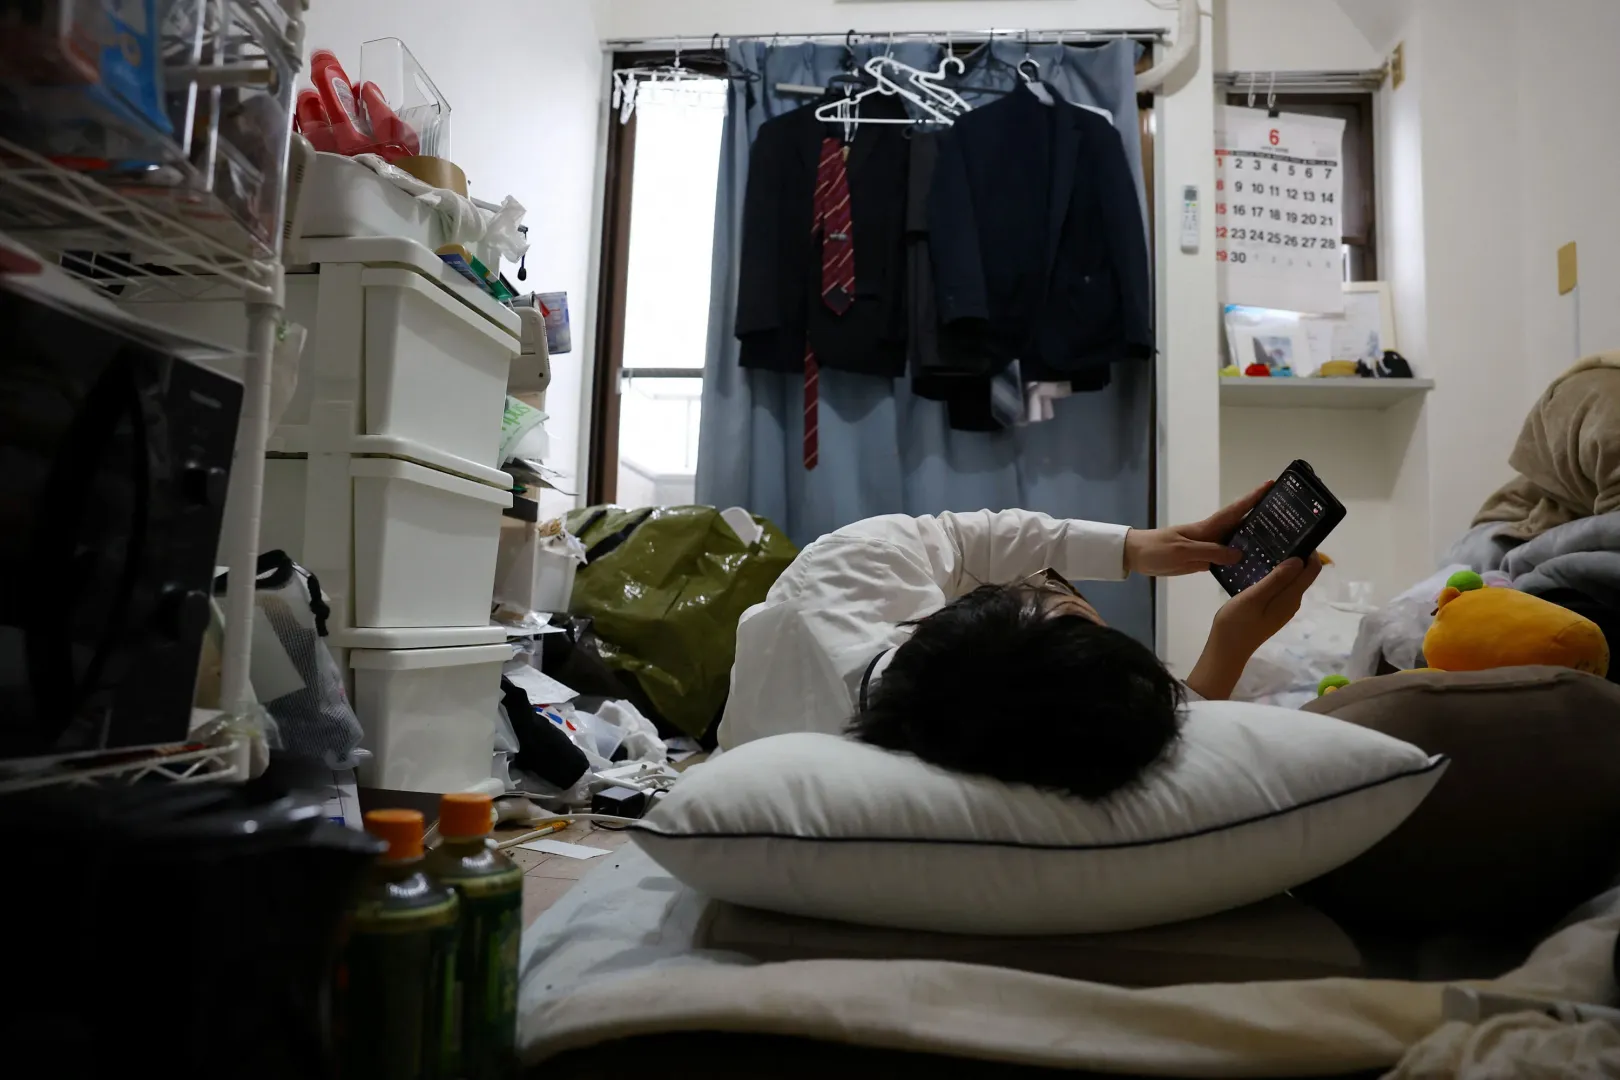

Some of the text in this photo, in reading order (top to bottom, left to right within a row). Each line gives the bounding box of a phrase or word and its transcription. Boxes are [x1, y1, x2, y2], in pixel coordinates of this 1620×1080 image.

[1268, 128, 1280, 146] 6
[1216, 157, 1333, 180] 1 2 3 4 5 6 7
[1234, 181, 1243, 193] 9
[1251, 183, 1265, 194] 10
[1269, 185, 1280, 197] 11
[1285, 188, 1299, 200] 12
[1302, 191, 1316, 202] 13
[1320, 192, 1335, 204] 14
[1232, 205, 1246, 216] 16
[1251, 206, 1264, 217] 17
[1269, 209, 1281, 220] 18
[1285, 211, 1298, 223] 19
[1300, 213, 1317, 225] 20
[1319, 215, 1334, 226] 21
[1230, 228, 1247, 240] 23
[1249, 229, 1265, 241] 24
[1266, 232, 1282, 244] 25
[1284, 235, 1299, 247] 26
[1301, 236, 1317, 248] 27
[1320, 238, 1336, 249] 28
[1230, 251, 1247, 264] 30
